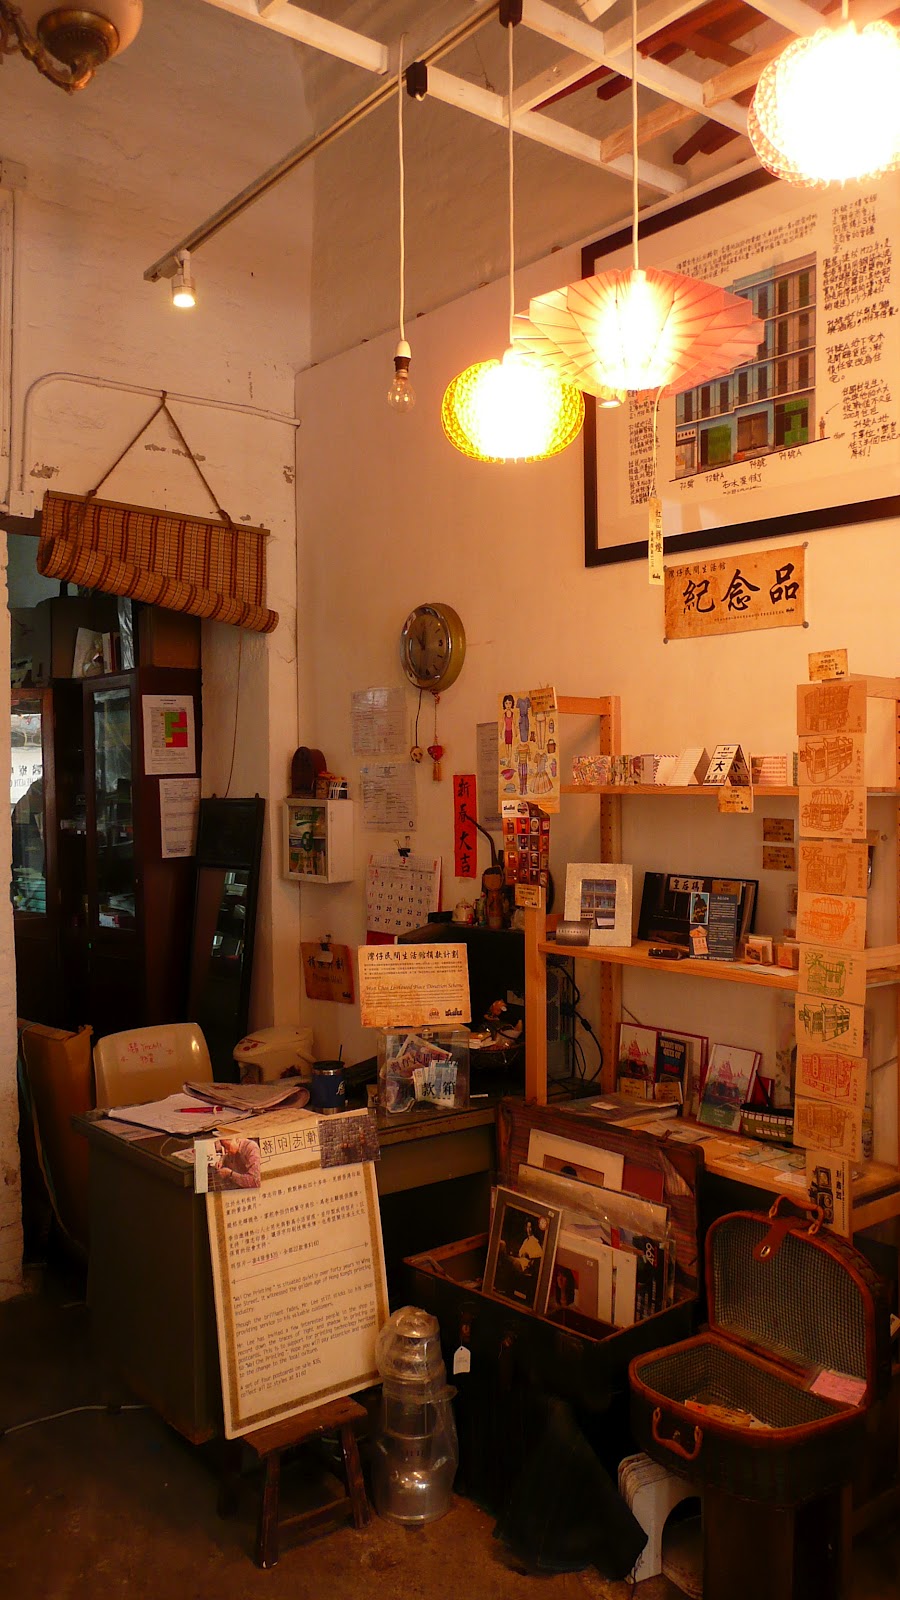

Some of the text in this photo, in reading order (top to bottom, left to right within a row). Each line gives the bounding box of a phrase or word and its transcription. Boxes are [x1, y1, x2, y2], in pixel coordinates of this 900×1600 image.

[682, 562, 800, 614] 紀念品
[366, 949, 460, 962] 灣仔民間生活館捐款計劃
